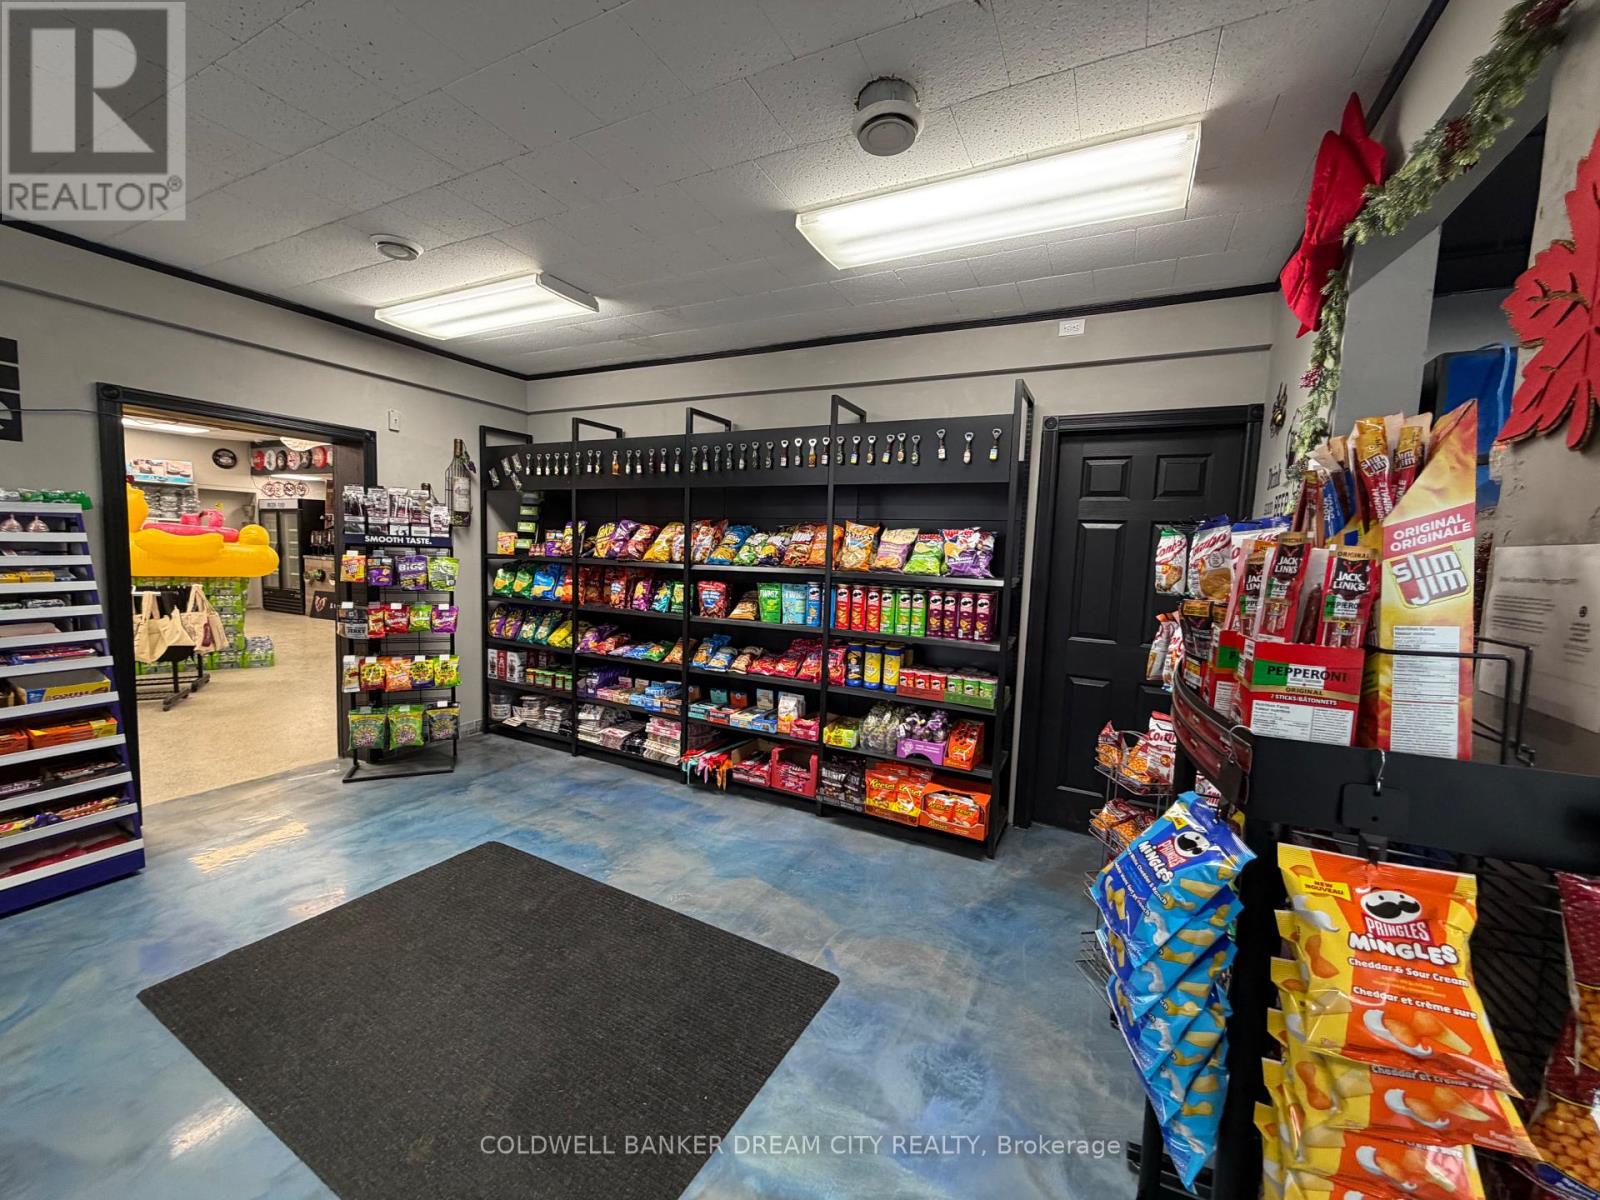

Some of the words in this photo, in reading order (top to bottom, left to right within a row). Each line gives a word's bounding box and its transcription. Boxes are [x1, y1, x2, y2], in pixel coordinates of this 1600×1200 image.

[1393, 513, 1466, 540] ORIGINAL
[364, 535, 404, 544] SMOOTH
[406, 537, 432, 545] TASTE.
[1390, 521, 1473, 552] ORIGINALE
[1278, 556, 1299, 566] JACK
[1247, 574, 1262, 583] JAC
[1336, 571, 1363, 582] JACK
[1267, 665, 1347, 682] PEPPERONI
[1285, 687, 1323, 696] ORIGINAL
[1304, 884, 1344, 895] NOUVEAU
[1313, 880, 1333, 888] NEW
[1365, 916, 1431, 942] PRINGLES
[1348, 956, 1393, 972] Cheddar
[1393, 965, 1404, 975] &
[1406, 967, 1430, 980] Sour
[1432, 972, 1469, 987] Cream
[1352, 986, 1399, 1002] Cheddar
[1400, 996, 1413, 1006] et
[1415, 999, 1451, 1014] crème
[1453, 1006, 1478, 1020] sure
